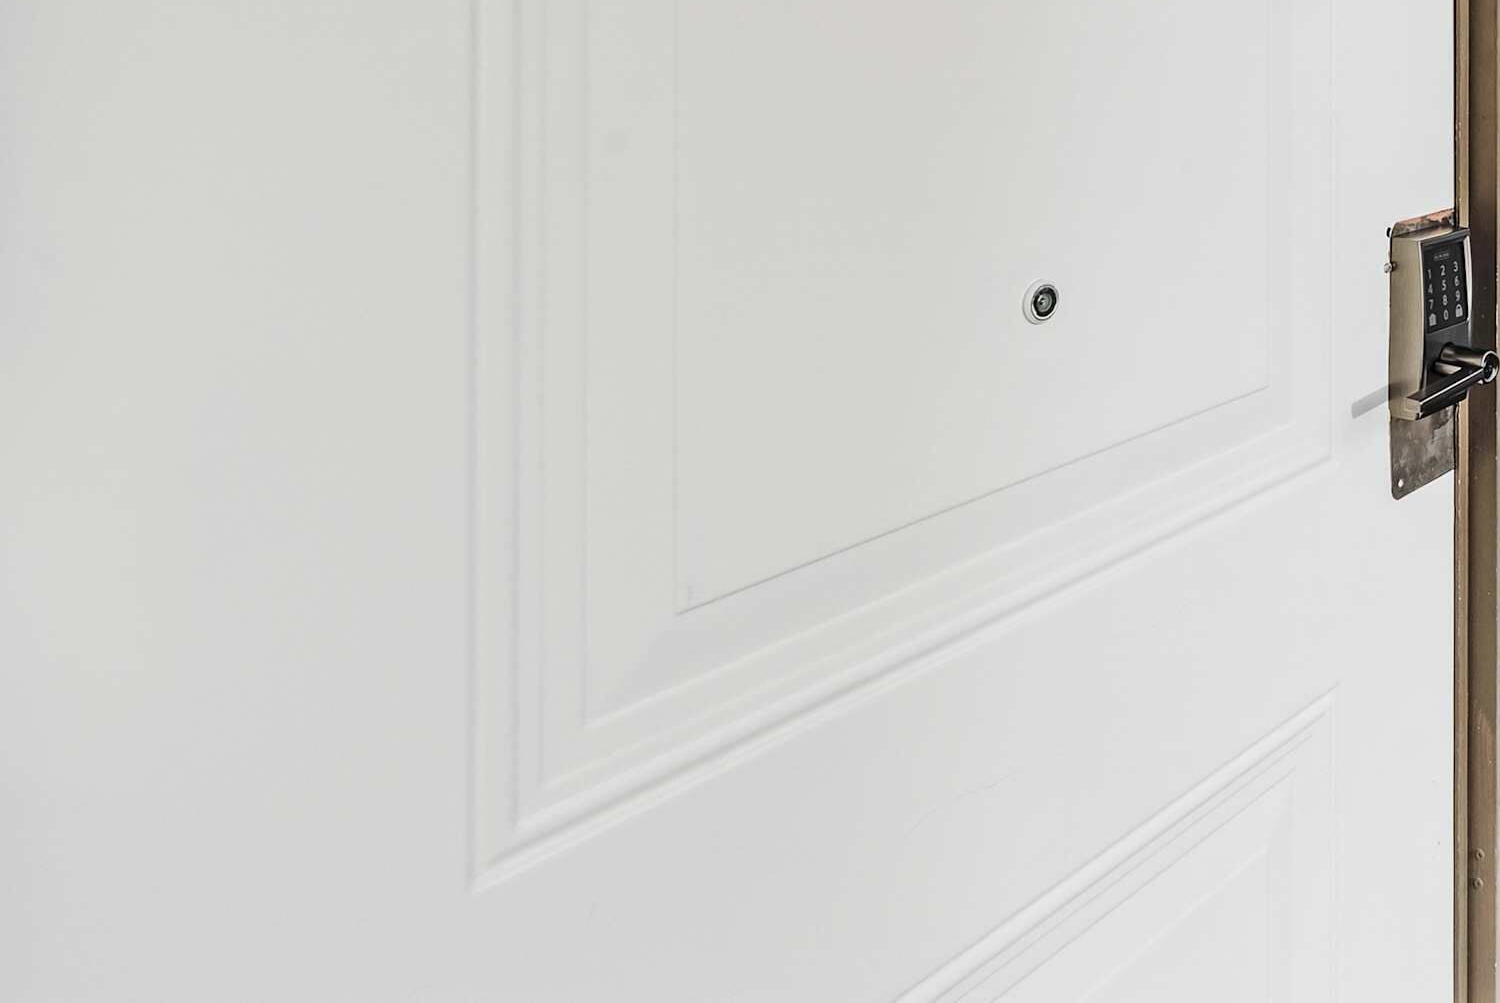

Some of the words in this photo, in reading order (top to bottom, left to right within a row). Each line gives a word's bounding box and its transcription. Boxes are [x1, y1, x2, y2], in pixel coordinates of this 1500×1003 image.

[1440, 265, 1446, 276] 2
[1453, 261, 1458, 272] 3
[1428, 284, 1433, 294] 4
[1442, 279, 1447, 291] 5
[1429, 299, 1434, 310] 7
[1442, 294, 1448, 306] 8
[1455, 290, 1460, 301] 9
[1443, 309, 1449, 320] 0
